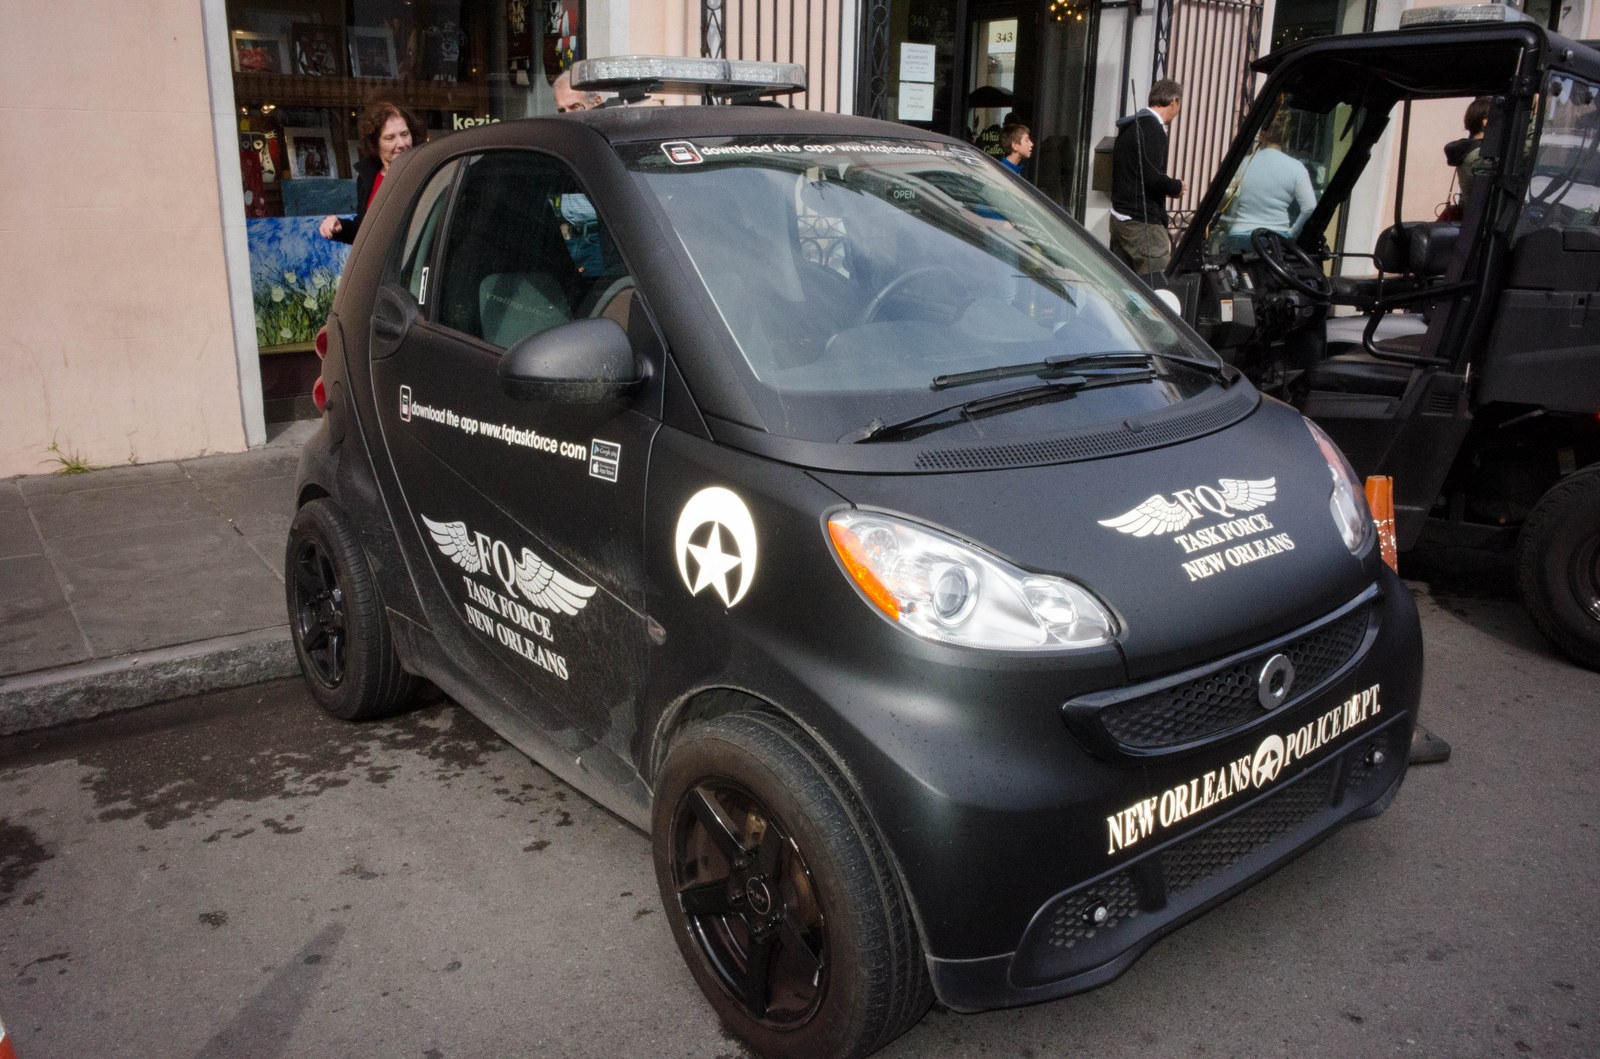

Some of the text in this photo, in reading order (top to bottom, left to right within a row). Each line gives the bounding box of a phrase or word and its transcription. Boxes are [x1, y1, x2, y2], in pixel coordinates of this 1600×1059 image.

[996, 32, 1013, 43] 343
[701, 144, 773, 156] download
[773, 143, 801, 153] the
[803, 144, 836, 154] app
[893, 190, 916, 199] OPEN
[411, 401, 446, 424] download
[446, 409, 459, 428] the
[460, 416, 479, 435] app
[1172, 485, 1235, 520] FQ
[1174, 513, 1274, 553] TASK FORCE
[474, 530, 519, 599] FQ
[1181, 532, 1295, 582] NEW ORLEANS
[463, 575, 554, 642] TASK FORCE
[464, 602, 569, 681] NEW ORLEANS
[1107, 683, 1381, 855] NEW ORLEANS POLICE DEPT.
